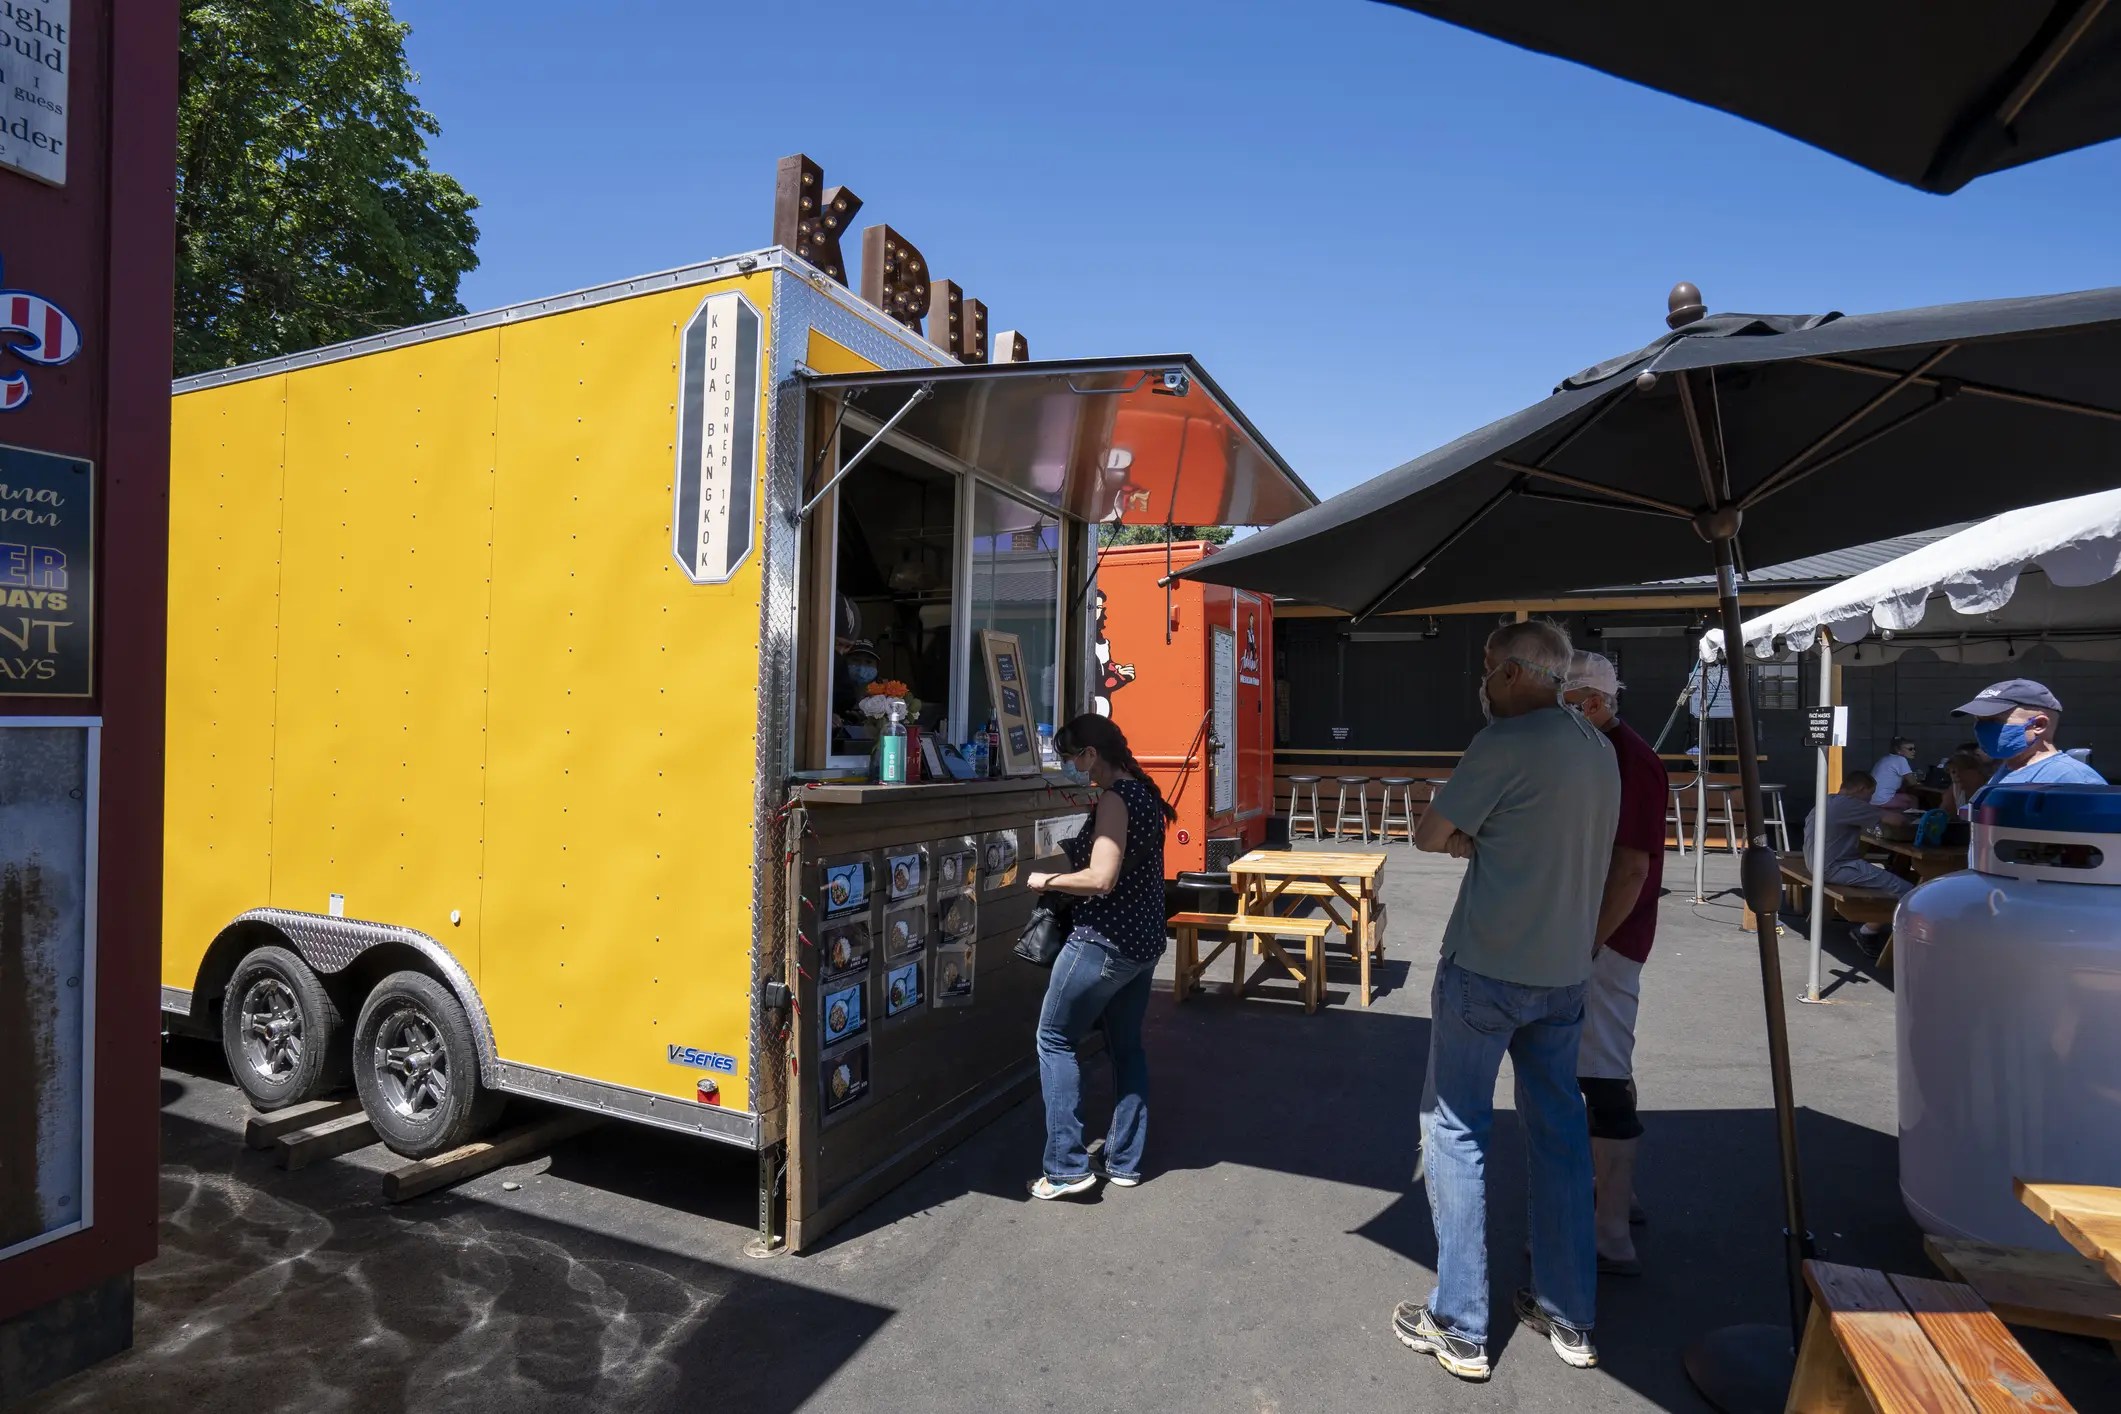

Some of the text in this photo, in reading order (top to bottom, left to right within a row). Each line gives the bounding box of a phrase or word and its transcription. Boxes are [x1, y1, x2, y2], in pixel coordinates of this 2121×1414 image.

[0, 0, 66, 44] ight
[14, 86, 63, 115] guess
[33, 76, 39, 89] I
[701, 314, 718, 567] KRUA BANGKOK
[719, 373, 731, 517] CORNER 14
[669, 1044, 734, 1071] V-Series
